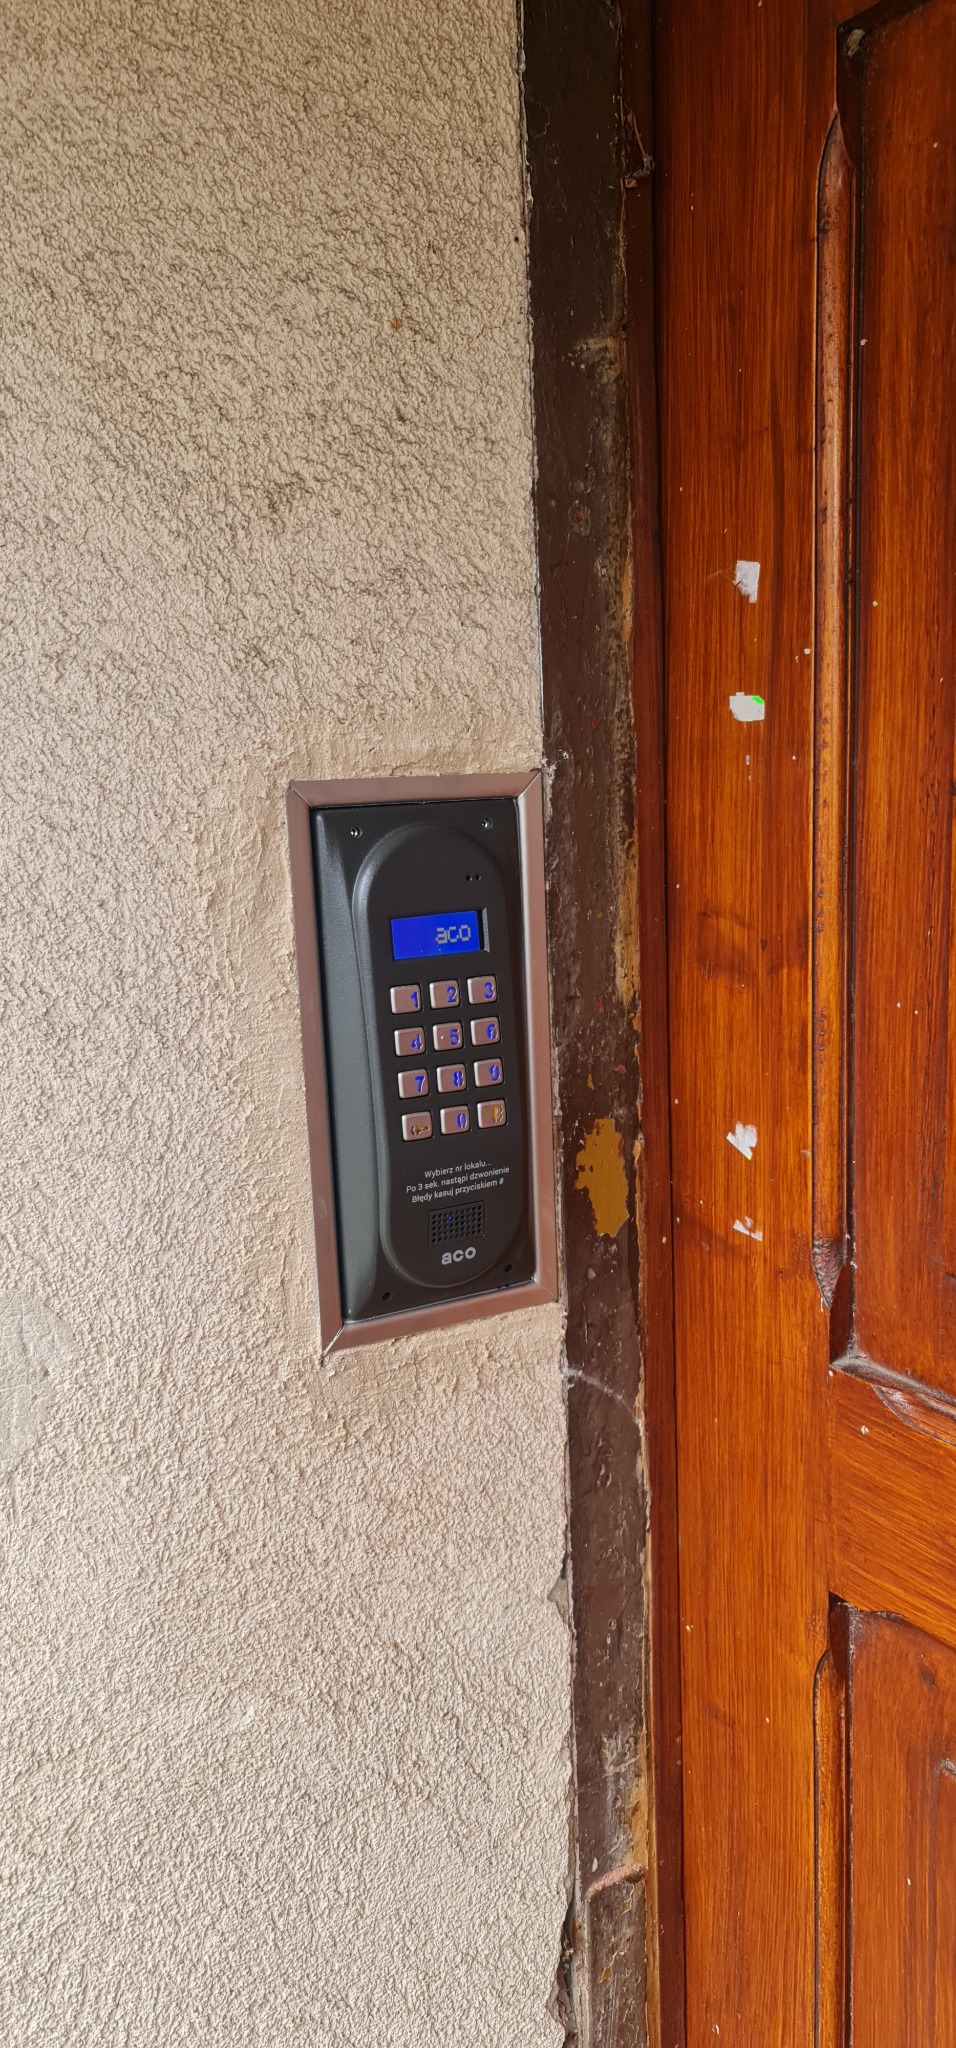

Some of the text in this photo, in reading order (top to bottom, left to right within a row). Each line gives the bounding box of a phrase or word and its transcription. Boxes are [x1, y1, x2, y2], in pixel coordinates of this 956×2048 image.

[435, 924, 471, 944] aco
[410, 982, 494, 1008] 1 2 3
[411, 1023, 498, 1050] 4 5 6
[415, 1065, 500, 1093] 7 8 9
[456, 1112, 467, 1129] 0
[406, 1166, 510, 1193] Po 3 sek. nastąpi dzwonienie
[424, 1167, 454, 1179] Wybierz
[464, 1160, 492, 1171] lokalu...
[412, 1193, 433, 1203] Błędy
[434, 1188, 454, 1198] kasuj
[455, 1180, 498, 1195] przyciskiem
[441, 1246, 477, 1265] aco
